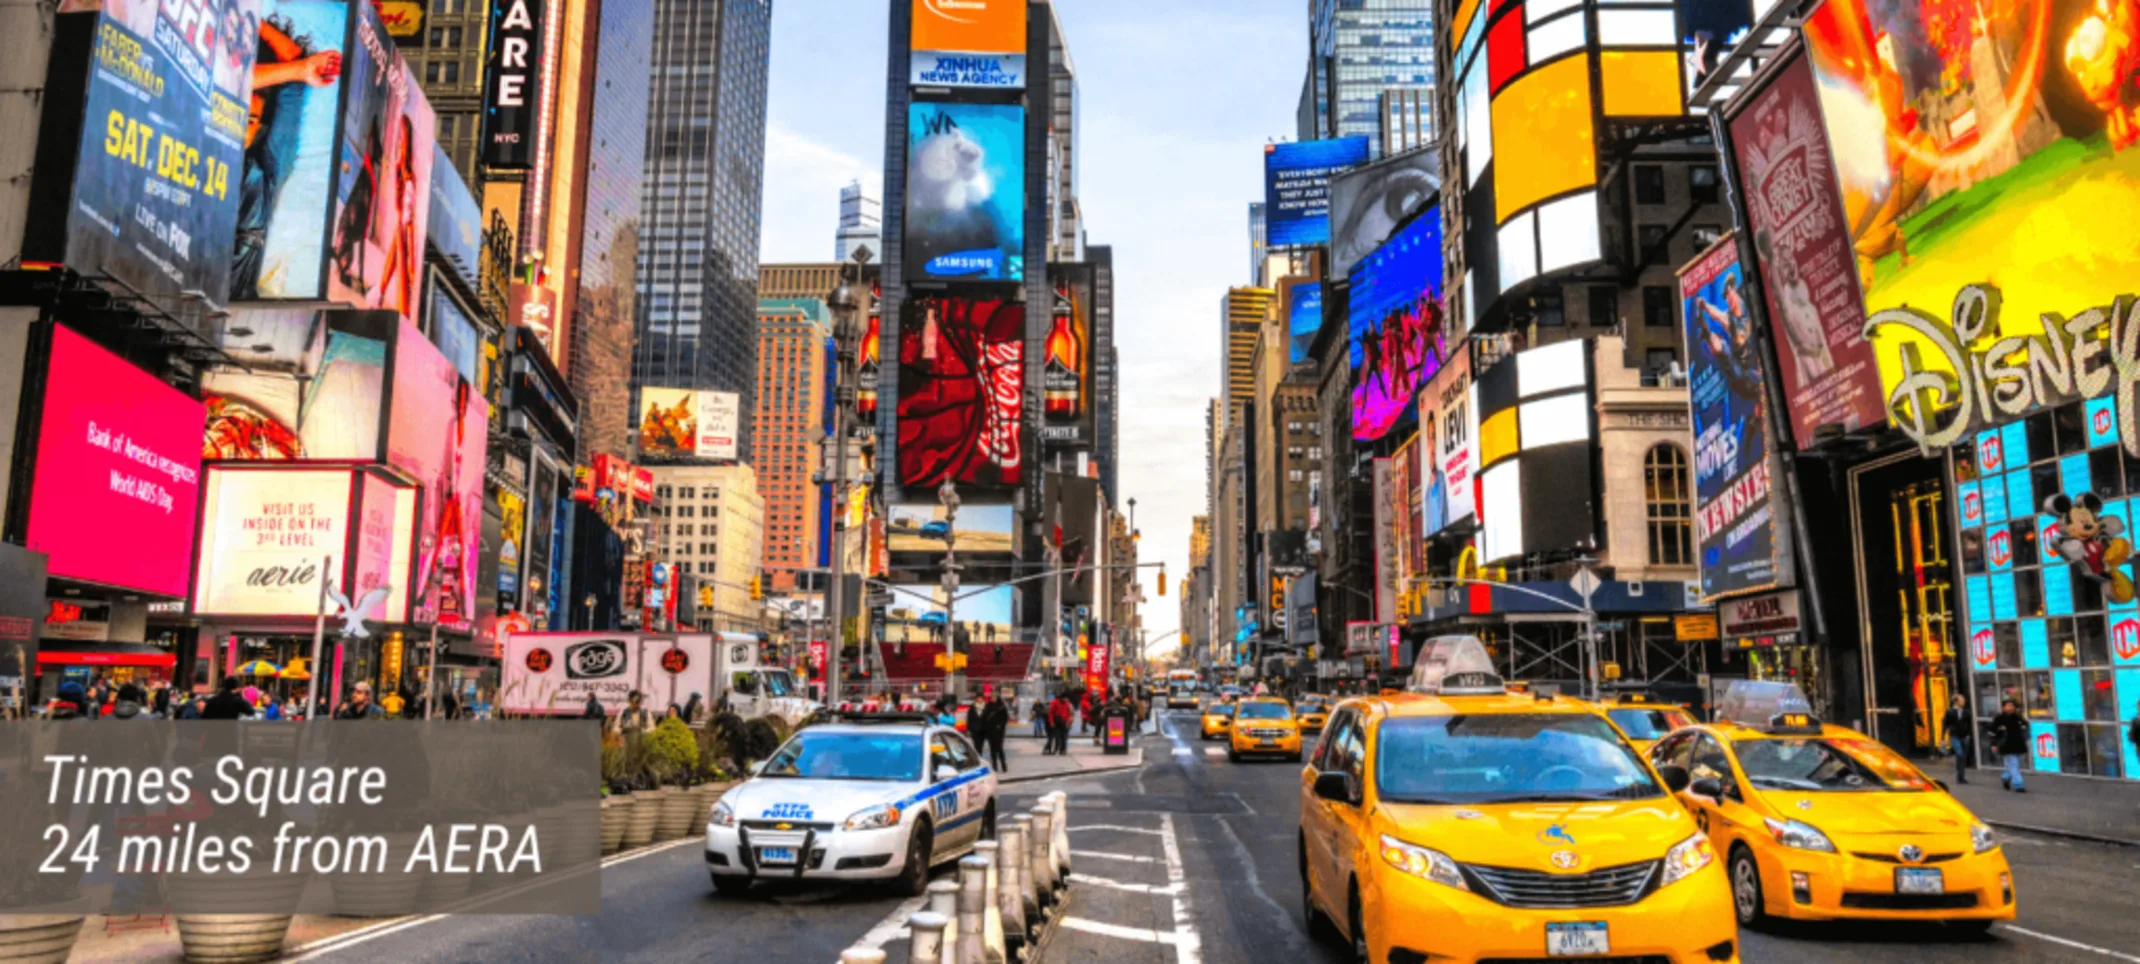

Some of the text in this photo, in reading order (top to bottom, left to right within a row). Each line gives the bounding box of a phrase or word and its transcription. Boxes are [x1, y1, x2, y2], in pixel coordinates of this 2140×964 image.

[935, 57, 1001, 72] XINHUA
[920, 71, 1017, 85] NEWS AGENCY
[494, 132, 521, 145] NYC
[203, 156, 229, 201] 14
[935, 256, 994, 269] SAMSUNG
[87, 420, 197, 485] Bank of America recognizes
[110, 468, 137, 498] World
[262, 503, 315, 516] VISIT US
[242, 518, 332, 532] INSIDE ON THE
[279, 533, 315, 547] LEVEL
[246, 557, 317, 587] aerie
[762, 809, 815, 821] POLICE
